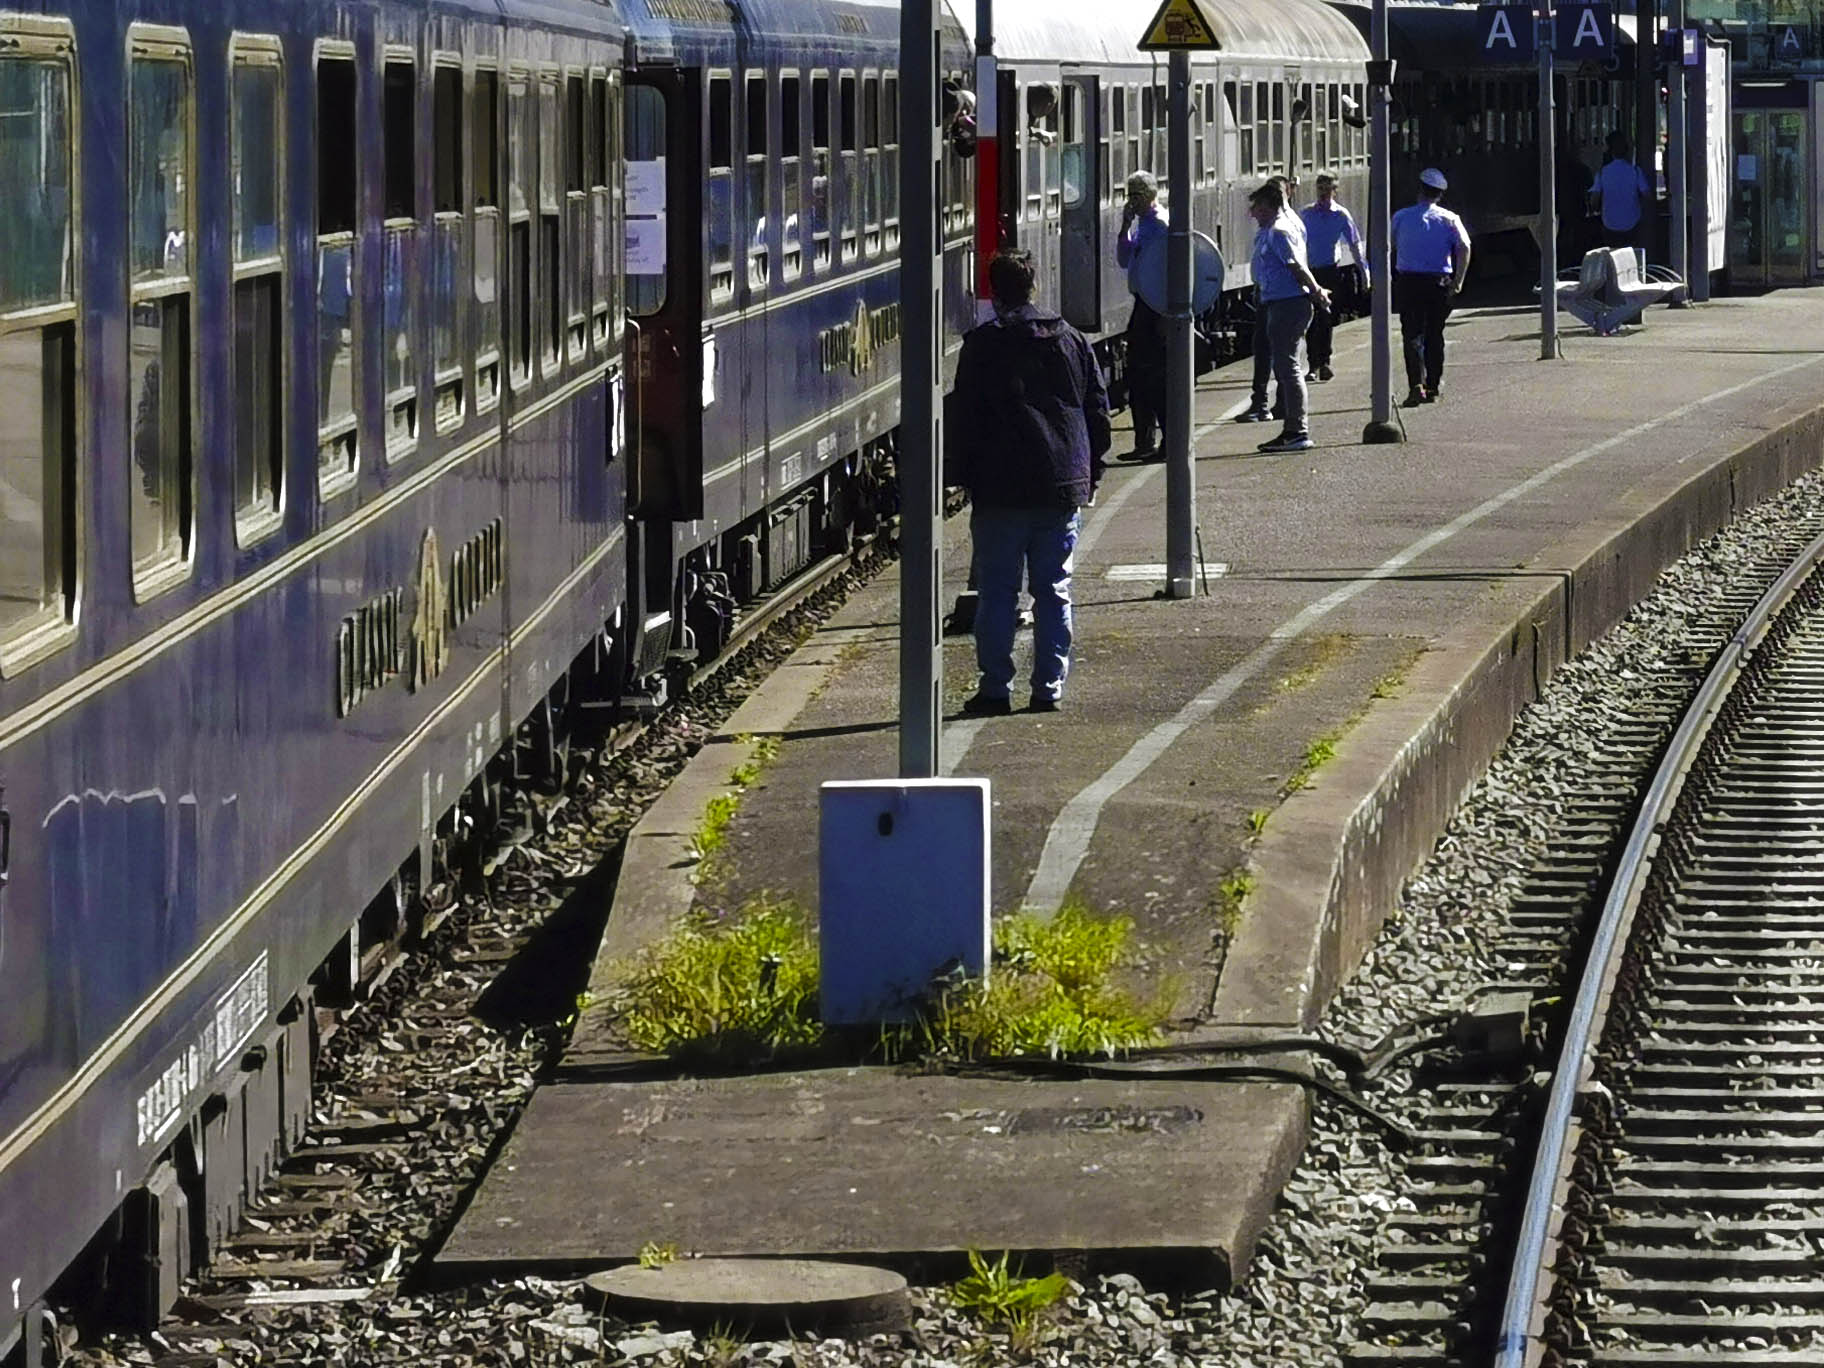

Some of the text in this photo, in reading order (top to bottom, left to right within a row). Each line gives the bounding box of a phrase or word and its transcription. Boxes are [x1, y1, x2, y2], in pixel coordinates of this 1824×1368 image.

[1485, 10, 1517, 48] A
[1572, 8, 1605, 47] A
[1783, 26, 1800, 49] A
